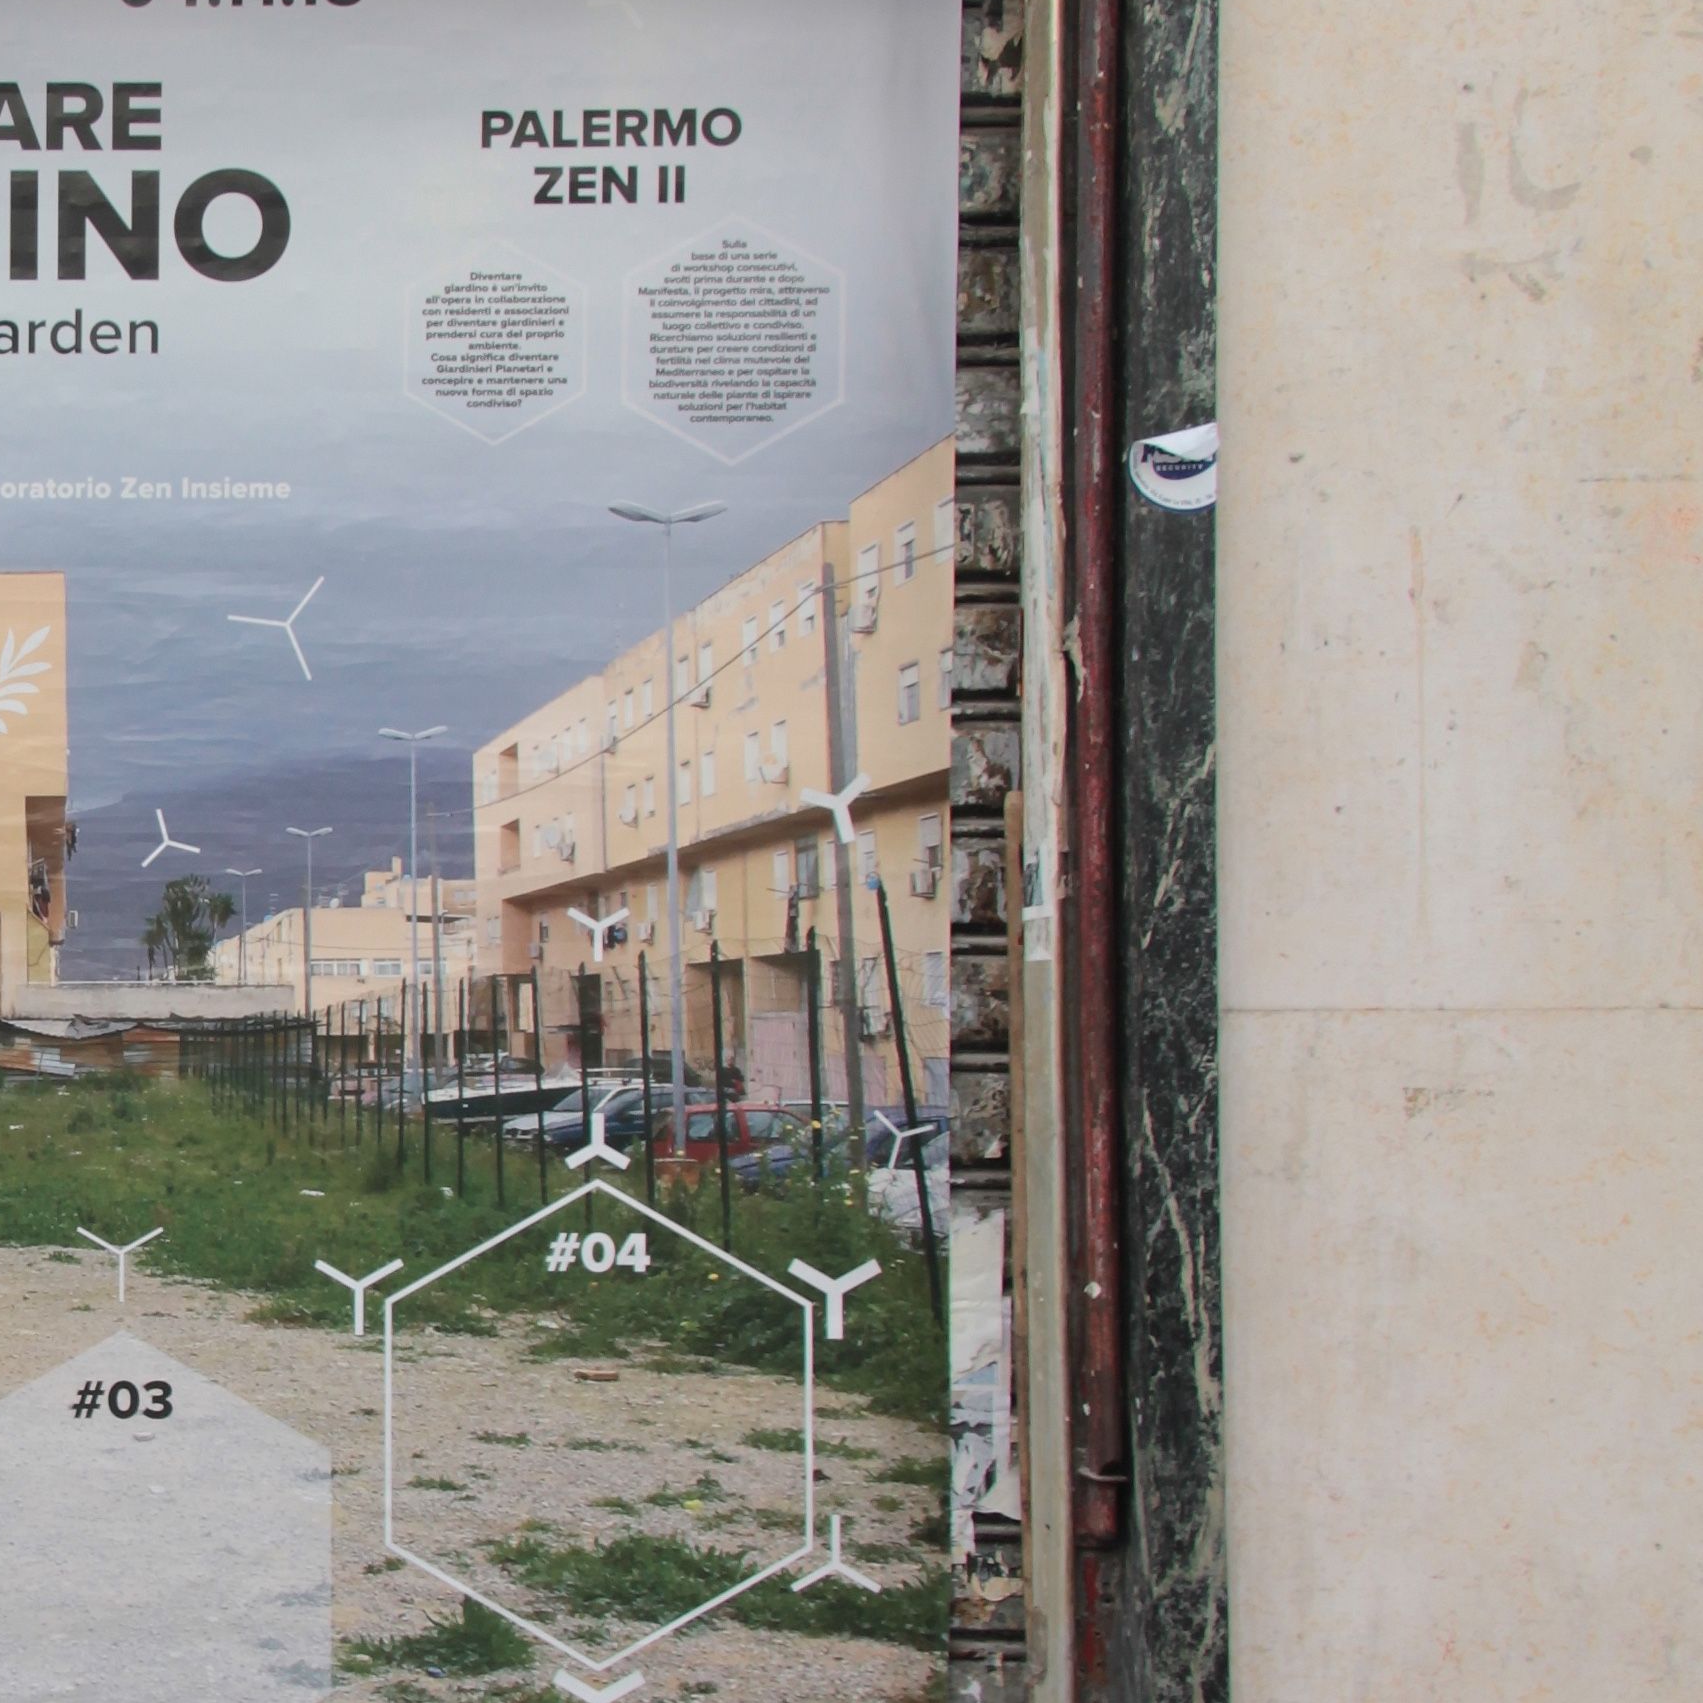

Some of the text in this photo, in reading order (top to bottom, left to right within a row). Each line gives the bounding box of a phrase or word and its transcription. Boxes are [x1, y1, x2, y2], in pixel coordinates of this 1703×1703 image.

[482, 108, 741, 148] PALERMO
[534, 166, 684, 204] ZEN II
[722, 240, 747, 248] Sulla
[691, 252, 716, 260] base
[753, 251, 778, 259] serie
[683, 263, 734, 274] workshop
[470, 272, 522, 280] Diventare
[664, 275, 691, 283] svolti
[693, 275, 723, 285] prima
[726, 275, 766, 283] durante
[778, 274, 805, 285] dopo
[444, 284, 489, 294] giardino
[638, 287, 691, 296] Manifesta,
[702, 287, 747, 297] progetto
[749, 286, 775, 295] mira,
[778, 286, 830, 294] attraverso
[425, 296, 471, 306] all'opera
[487, 295, 566, 303] collaborazione
[658, 298, 737, 308] coinvolgimento
[740, 298, 756, 306] dei
[758, 297, 802, 307] cittadini,
[445, 307, 491, 315] residenti
[504, 307, 569, 315] associazioni
[715, 309, 788, 320] responsabilità
[426, 321, 443, 329] per
[447, 318, 498, 327] diventare
[501, 318, 555, 329] giardinieri
[662, 322, 692, 332] luogo
[694, 321, 741, 330] collettivo
[753, 321, 804, 329] condiviso.
[426, 330, 477, 340] prendersi
[506, 330, 523, 338] del
[526, 330, 565, 340] proprio
[650, 334, 714, 342] Ricerchiamo
[716, 333, 762, 341] soluzioni
[764, 333, 808, 341] resilienti
[650, 345, 694, 353] durature
[697, 347, 714, 355] per
[752, 344, 805, 352] condizioni
[431, 353, 559, 363] Cosa significa diventare
[656, 355, 810, 365] fertilità nel clima mutevole del
[437, 364, 492, 373] Giardinieri
[495, 364, 544, 372] Planetari
[656, 368, 725, 376] Mediterraneo
[737, 369, 754, 378] per
[757, 367, 798, 377] ospitare
[422, 376, 474, 386] concepire
[486, 376, 544, 384] mantenere
[649, 379, 709, 388] biodiversità
[711, 379, 759, 387] rivelando
[773, 378, 816, 389] capacità
[472, 387, 503, 395] forma
[519, 387, 554, 397] spazio
[653, 391, 696, 399] naturale
[698, 391, 723, 399] delle
[726, 391, 759, 401] piante
[773, 390, 812, 400] ispirare
[466, 399, 522, 407] condiviso?
[678, 402, 787, 412] soluzioni per l'habitat
[690, 414, 774, 424] contemporaneo.
[121, 477, 171, 498] Zen
[182, 477, 291, 499] Insieme
[546, 1232, 650, 1272] #04
[72, 1381, 172, 1419] #03
